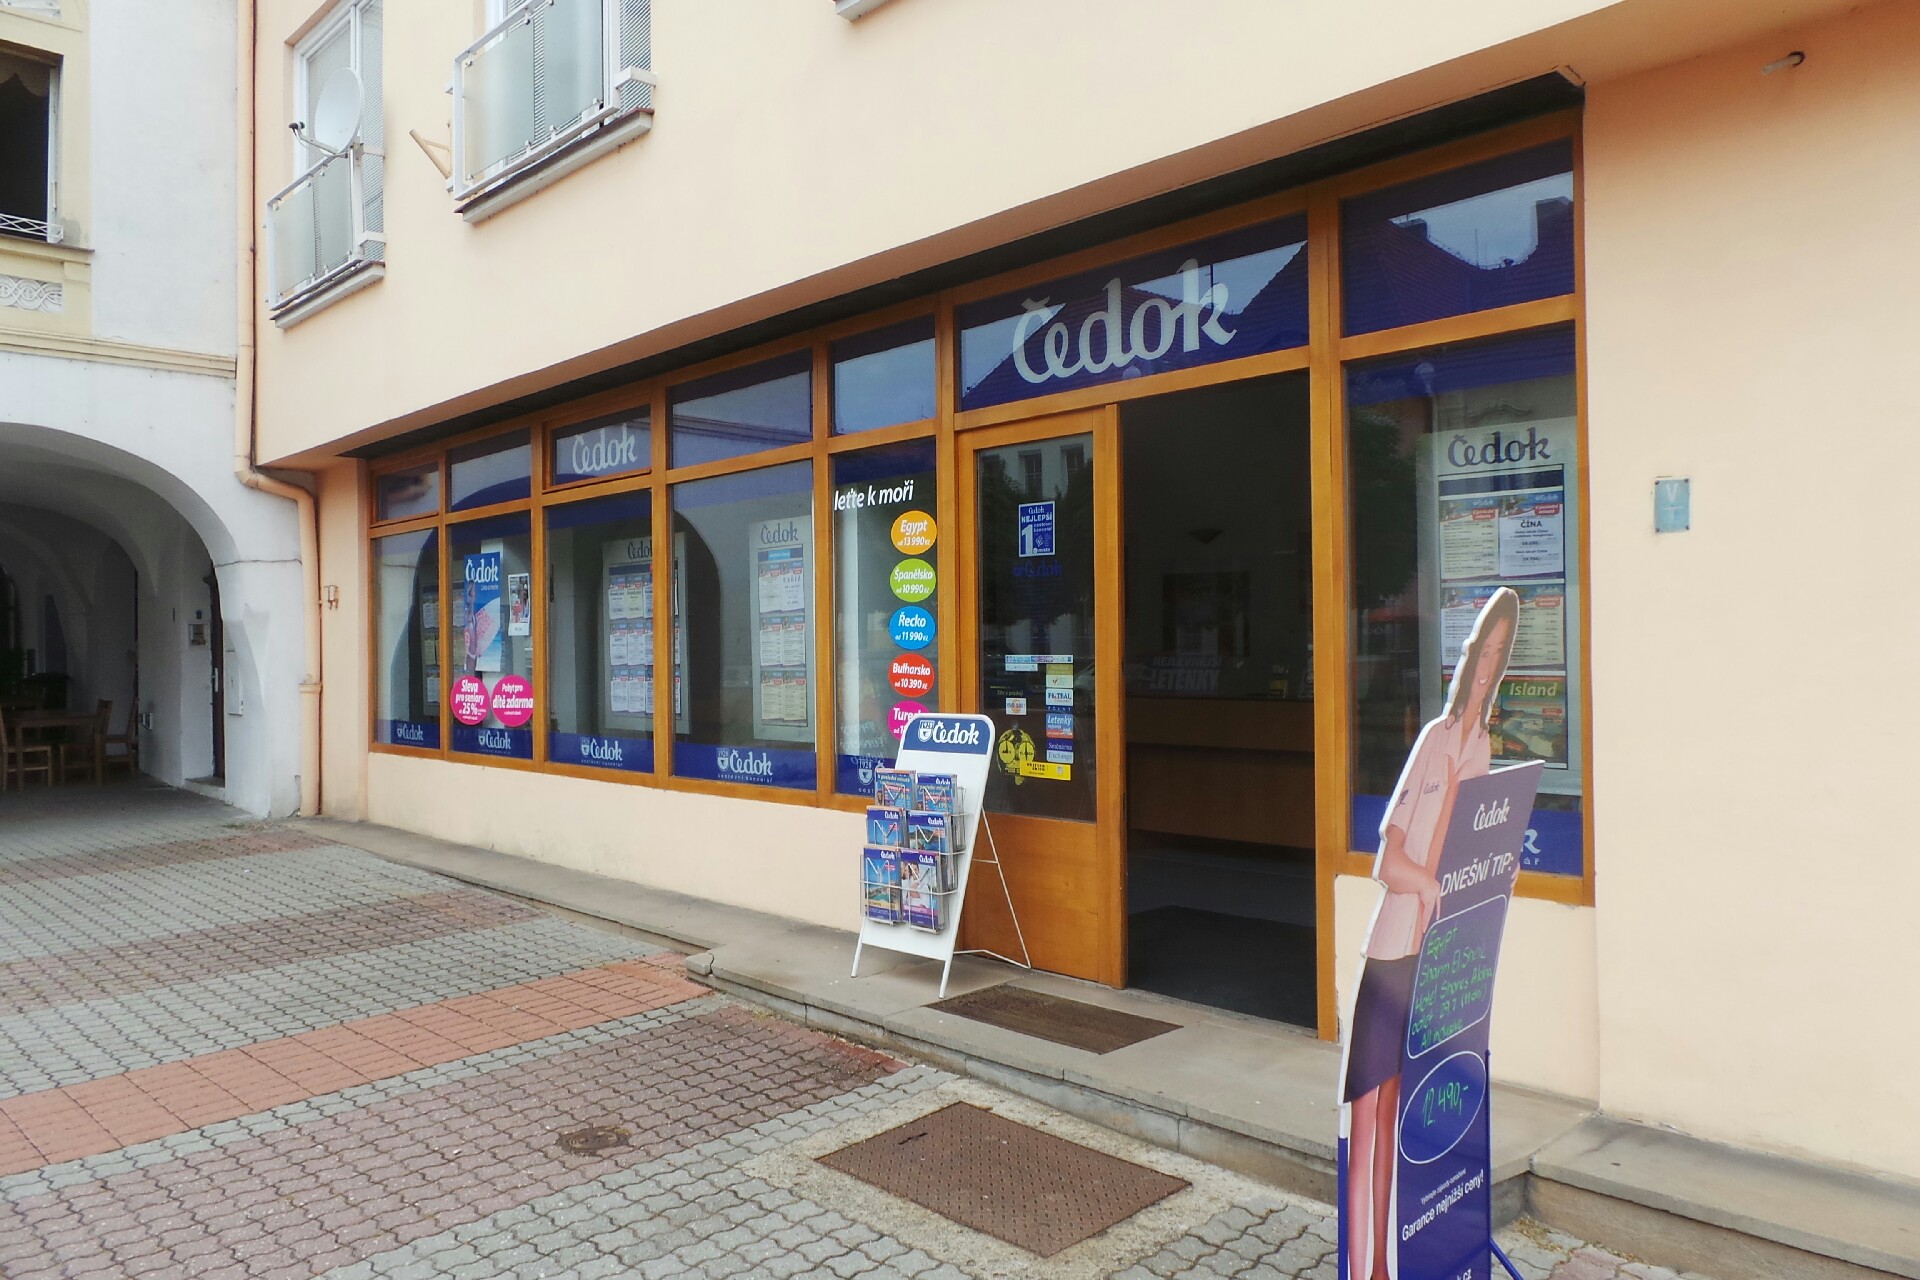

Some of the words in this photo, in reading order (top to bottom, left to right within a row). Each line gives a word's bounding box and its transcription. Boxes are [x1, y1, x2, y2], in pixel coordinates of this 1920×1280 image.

[1013, 259, 1237, 384] Čedok
[573, 423, 637, 474] Čedok
[1448, 427, 1551, 467] Čedok
[834, 488, 864, 510] leťte
[867, 485, 876, 506] k
[879, 480, 914, 505] moři
[1021, 512, 1052, 523] NEJLEPŠÍ
[761, 521, 798, 544] Čedok
[901, 520, 928, 535] Egypt
[903, 537, 910, 546] 13
[912, 536, 924, 546] 990
[1022, 524, 1033, 555] 1
[627, 541, 652, 560] Čedo
[465, 558, 499, 583] Čedok
[894, 567, 933, 582] Španělsko
[902, 584, 910, 594] 10
[910, 584, 924, 594] 990
[898, 611, 926, 627] Řecko
[902, 631, 908, 640] 11
[909, 631, 923, 641] 990
[892, 662, 930, 676] Bulharsko
[461, 679, 479, 693] Sleva
[502, 683, 514, 693] Pobyt
[514, 684, 524, 693] pro
[901, 678, 908, 688] 10
[908, 679, 922, 689] 390
[1510, 682, 1557, 697] Island
[455, 693, 465, 704] pro
[493, 695, 506, 708] dítě
[506, 695, 533, 709] zdarma
[893, 707, 921, 720] Ture
[1048, 715, 1072, 727] Letenky
[402, 723, 424, 741] Čedok
[486, 730, 511, 749] Čedok
[932, 720, 979, 745] Čedok
[590, 738, 623, 761] Čedok
[729, 749, 773, 776] Čedok
[1473, 797, 1510, 832] Čedok
[1440, 852, 1493, 897] DNEŠNÍ
[1492, 852, 1514, 877] TIP:
[1402, 1208, 1436, 1241] Garance
[1436, 1182, 1464, 1215] nejnižší
[1464, 1168, 1484, 1194] ceny!
